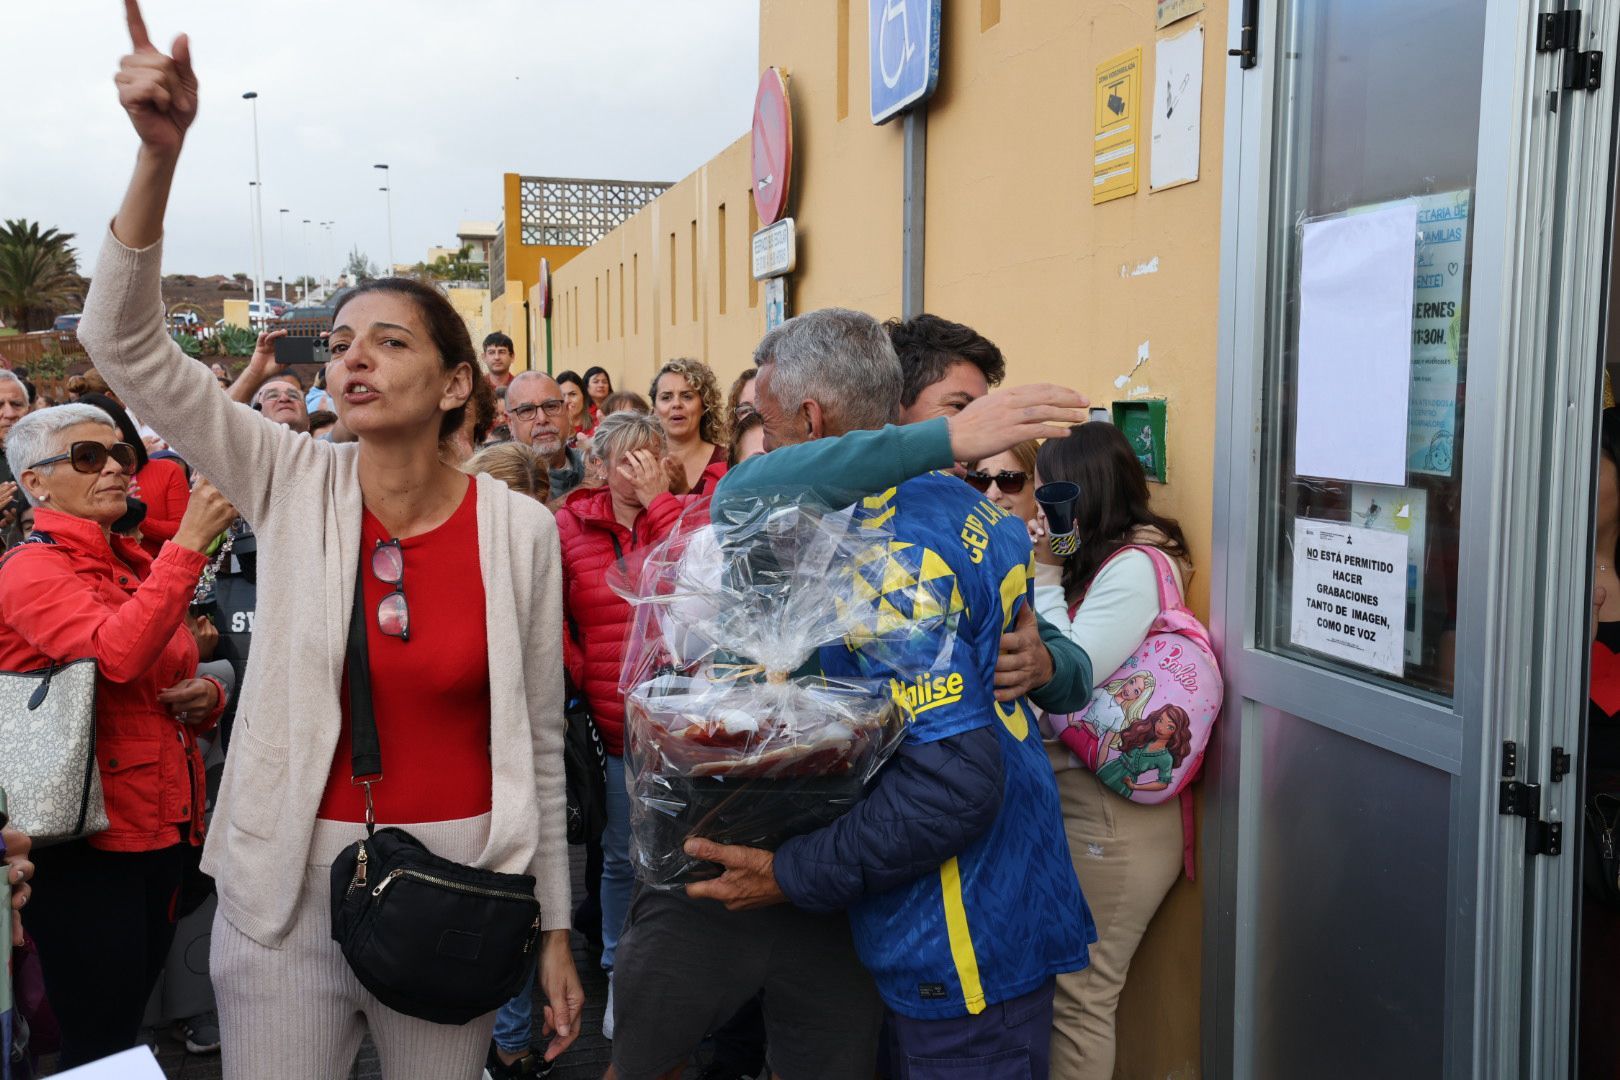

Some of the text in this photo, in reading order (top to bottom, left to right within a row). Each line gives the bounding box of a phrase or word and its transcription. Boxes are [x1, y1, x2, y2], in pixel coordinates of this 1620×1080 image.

[1454, 204, 1466, 217] DE
[961, 514, 988, 563] CEIP
[1307, 547, 1393, 574] NO ESTÁ PERMITIDO
[1332, 569, 1362, 585] HACER
[1316, 583, 1378, 607] GRABACIONES
[1306, 597, 1390, 630] TANTO DE IMAGEN,
[1317, 617, 1376, 642] COMO DE VOZ
[1158, 643, 1198, 694] Barbie
